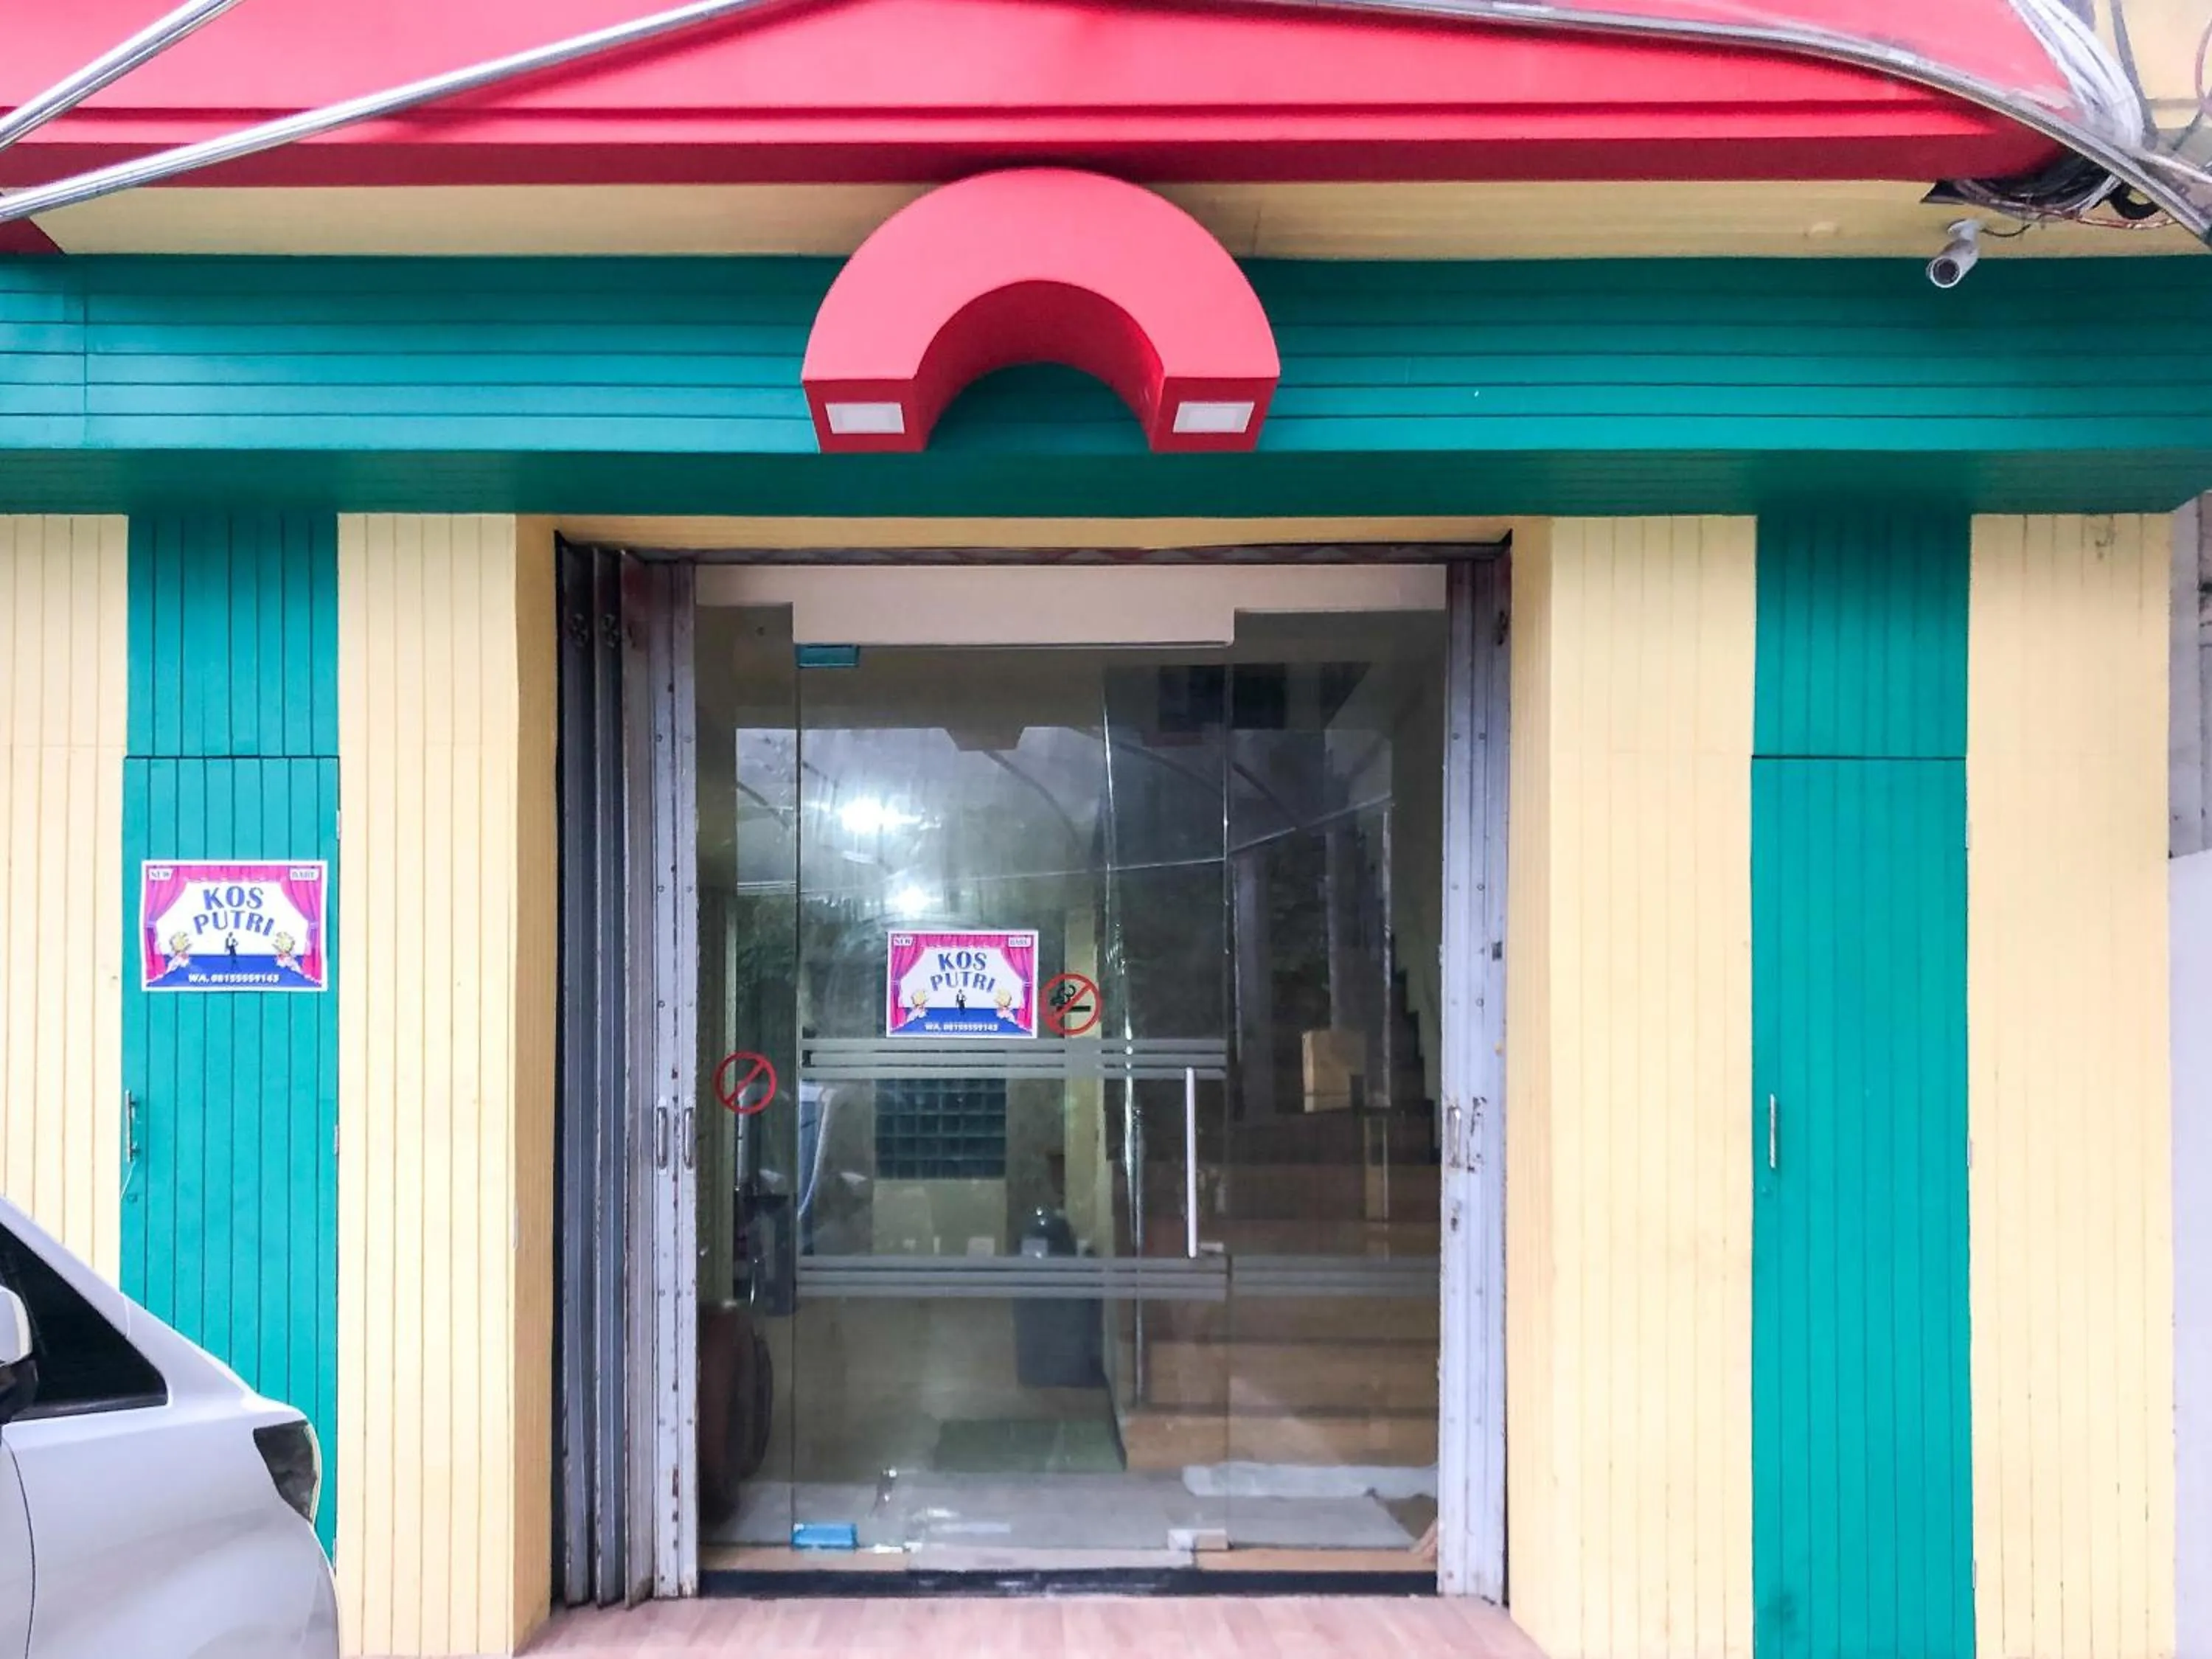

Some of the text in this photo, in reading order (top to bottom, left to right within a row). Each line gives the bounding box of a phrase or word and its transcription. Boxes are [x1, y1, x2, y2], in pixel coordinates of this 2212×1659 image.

[203, 886, 264, 911] KOS
[193, 910, 274, 936] PUTRI
[937, 950, 987, 972] KOS
[930, 971, 995, 992] PUTRI
